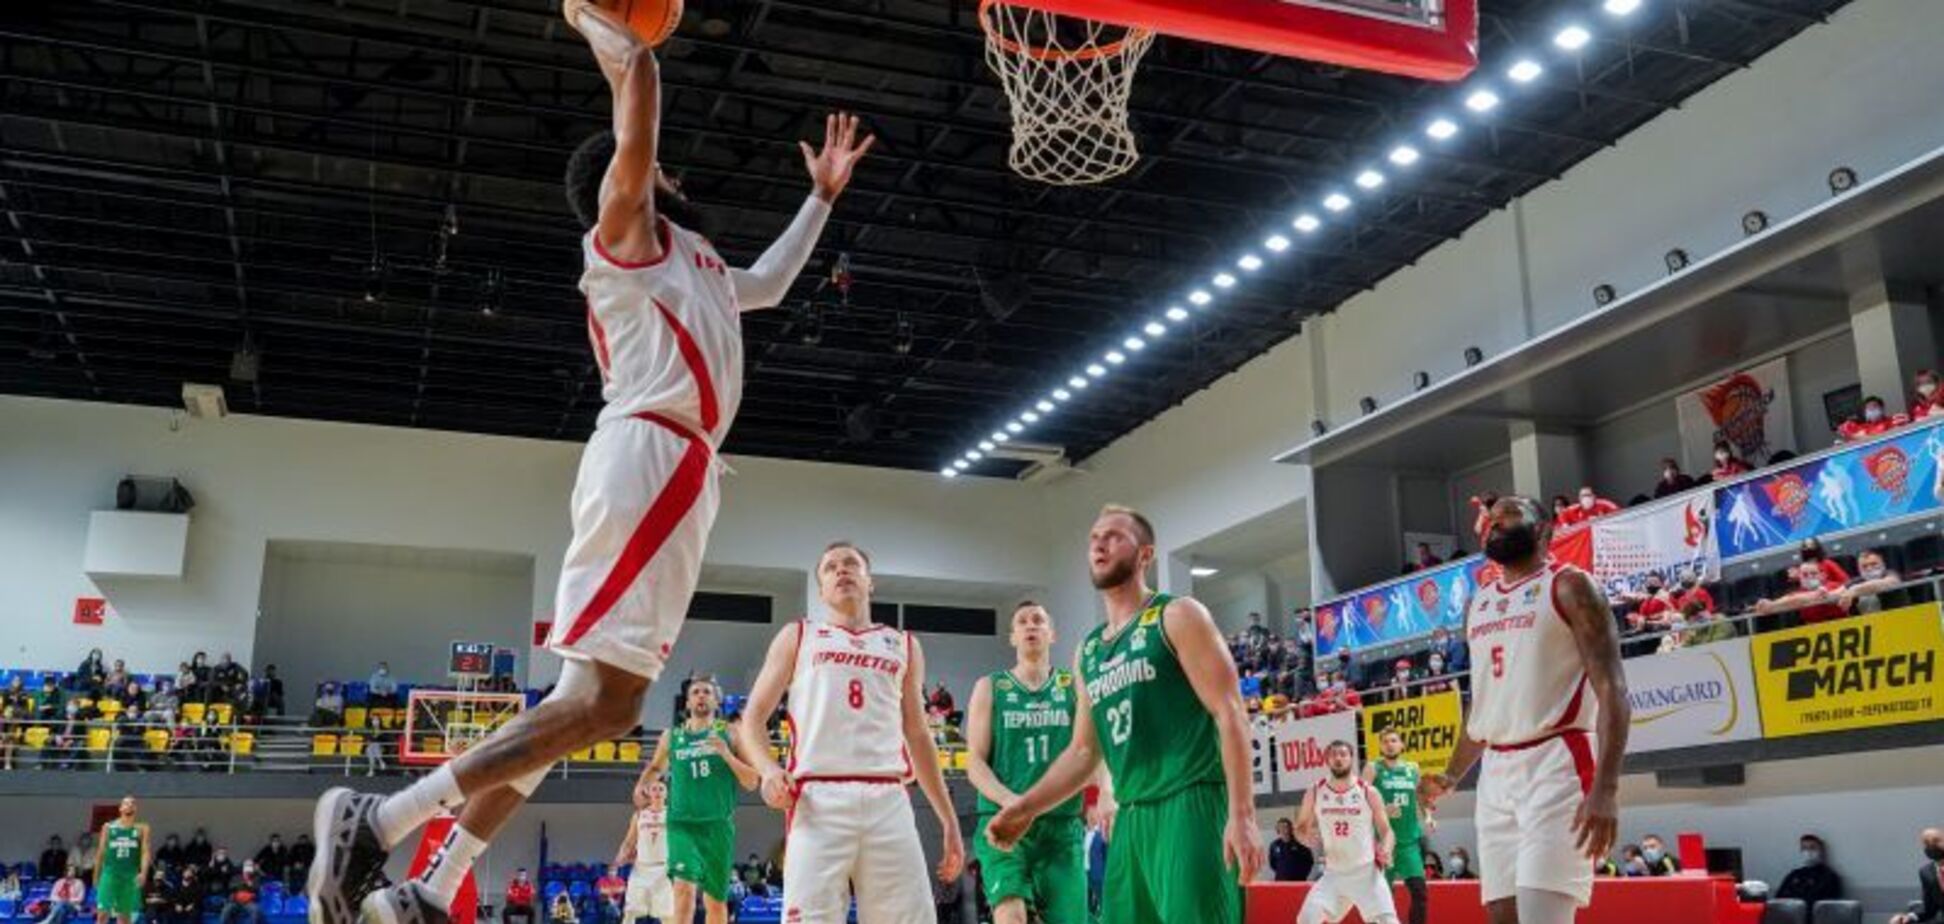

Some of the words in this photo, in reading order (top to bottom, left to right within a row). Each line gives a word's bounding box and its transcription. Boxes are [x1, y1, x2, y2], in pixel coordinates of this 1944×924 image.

[1790, 625, 1871, 668] PARI
[1491, 646, 1504, 678] 5
[1811, 650, 1935, 698] MATCH
[848, 679, 864, 709] 8
[1106, 699, 1132, 746] 23
[1024, 734, 1049, 764] 11
[1401, 723, 1455, 753] ATCH
[690, 759, 711, 779] 18
[1333, 821, 1349, 836] 22
